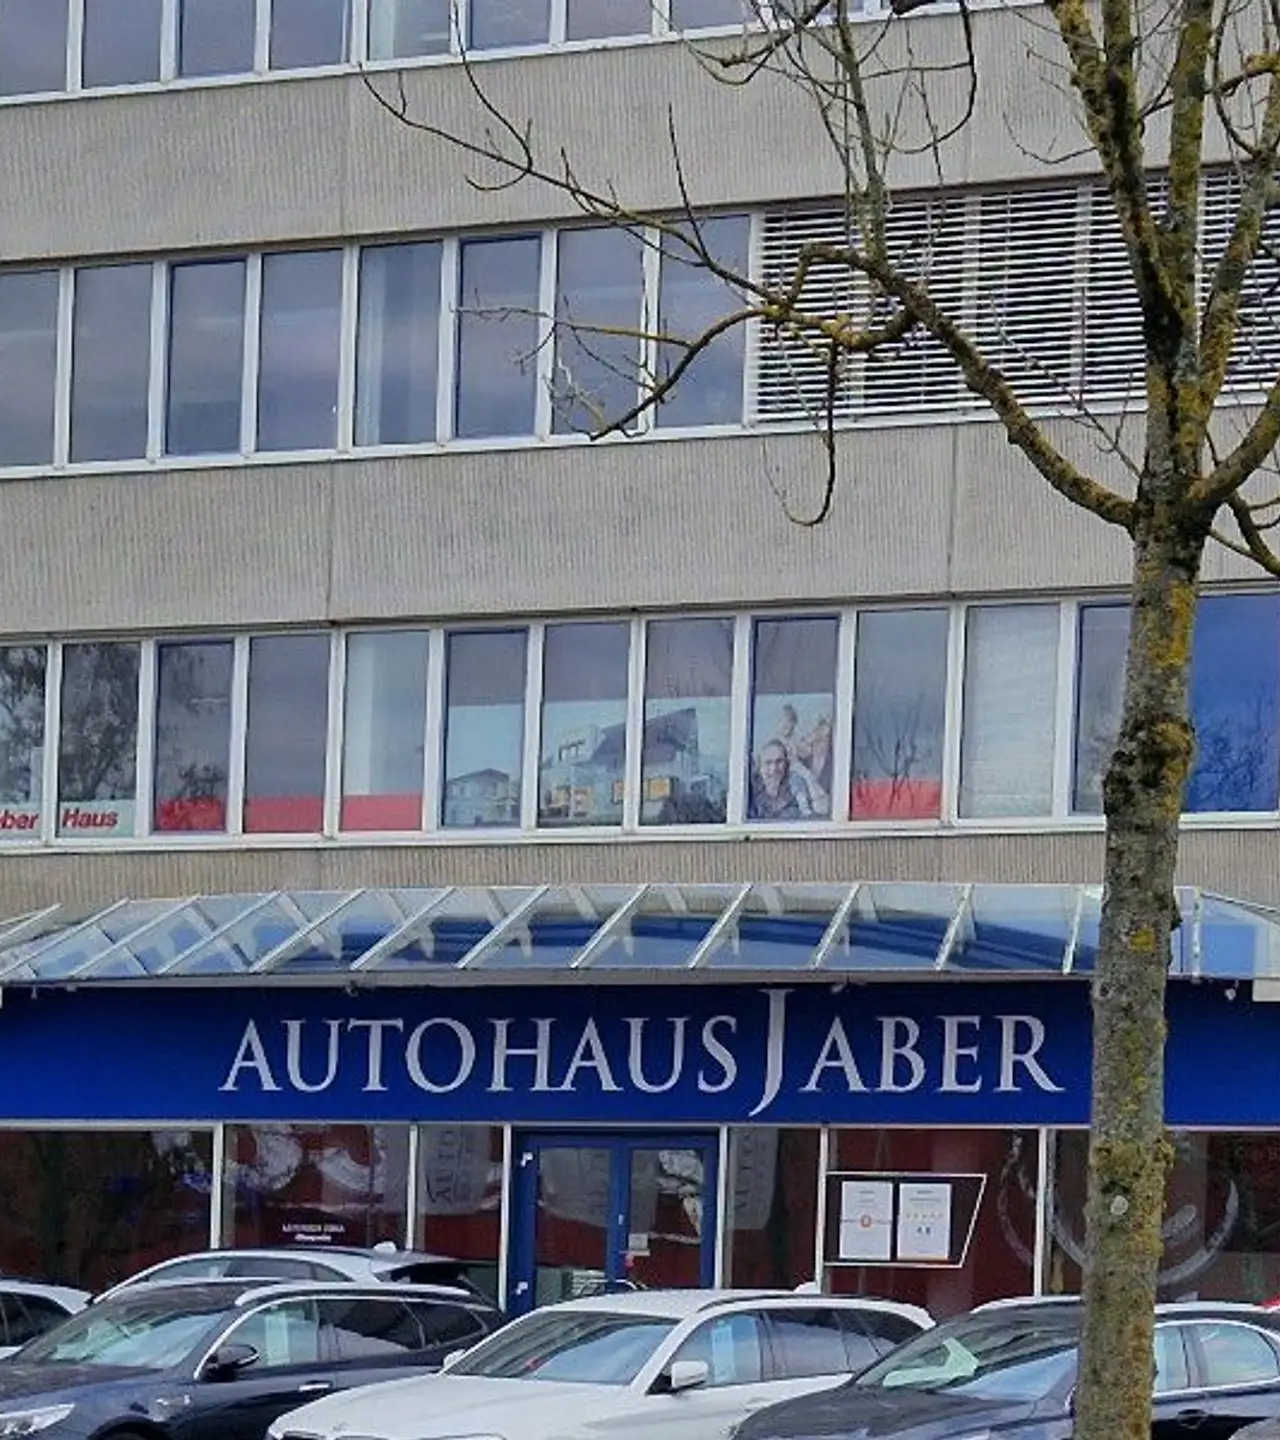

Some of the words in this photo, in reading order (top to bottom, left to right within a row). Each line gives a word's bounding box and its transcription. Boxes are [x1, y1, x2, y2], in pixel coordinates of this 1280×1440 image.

[61, 807, 118, 829] Haus
[219, 1014, 738, 1094] AUTOHAUS
[748, 989, 1065, 1118] JABER
